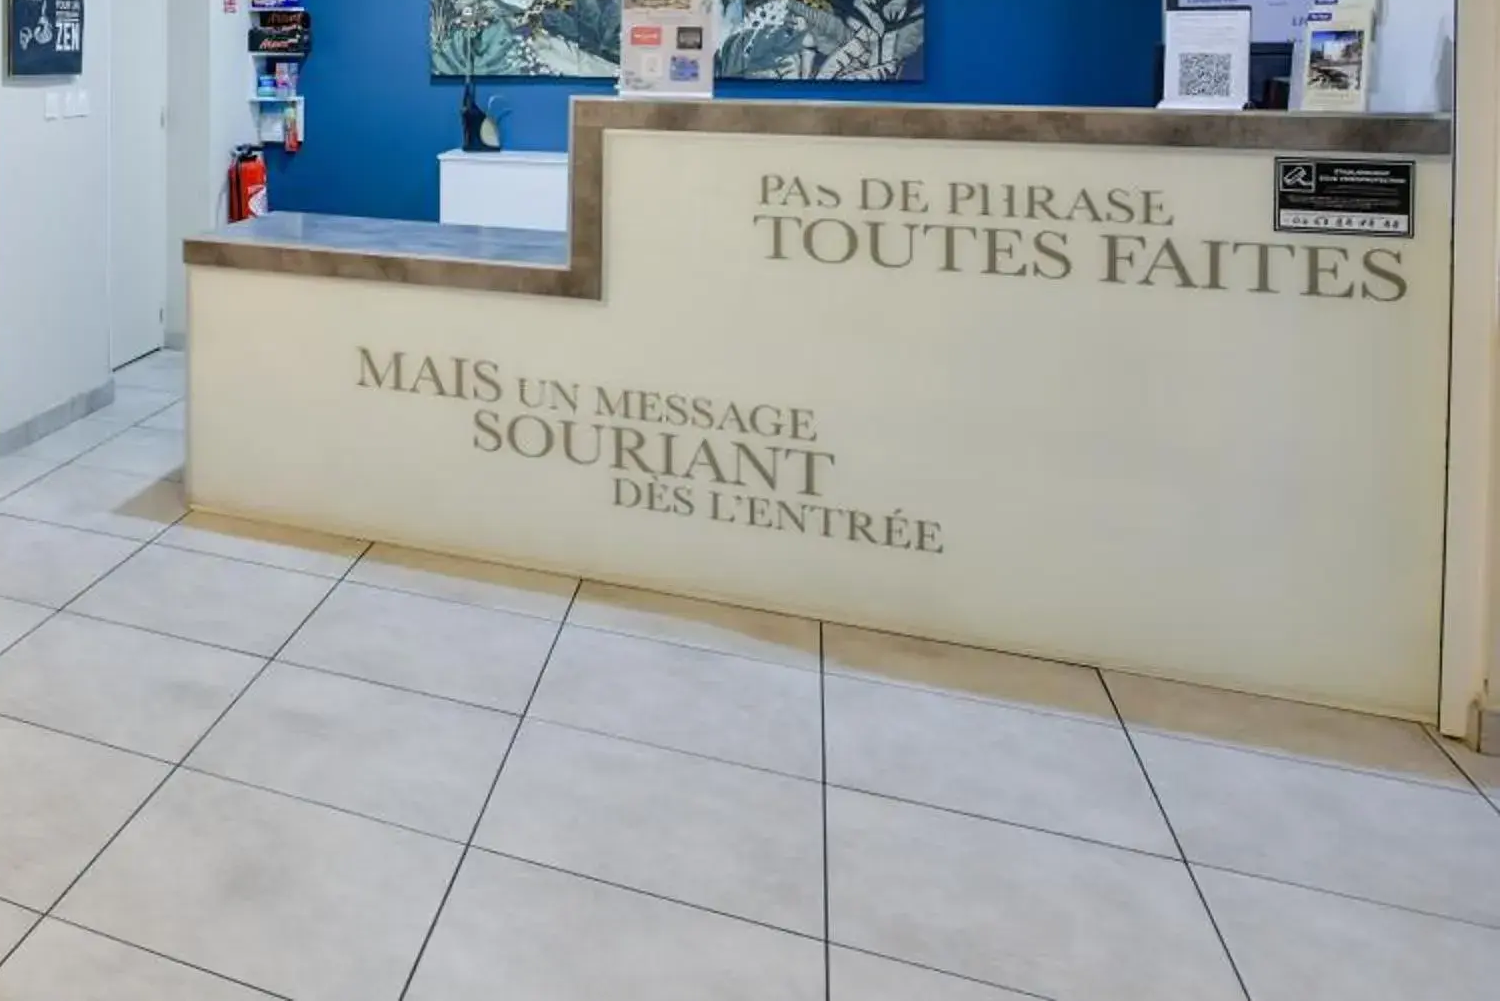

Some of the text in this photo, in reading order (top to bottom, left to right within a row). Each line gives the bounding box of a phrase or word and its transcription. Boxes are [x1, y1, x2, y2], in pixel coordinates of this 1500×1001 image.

[858, 177, 930, 214] DE
[947, 181, 1176, 227] PHRASE
[752, 214, 1409, 302] TOUTES FAITES
[355, 345, 820, 443] MAIS UN MESSAGE
[472, 407, 838, 497] SOURIANT
[610, 474, 945, 555] DÈS L'ENTRÉE
